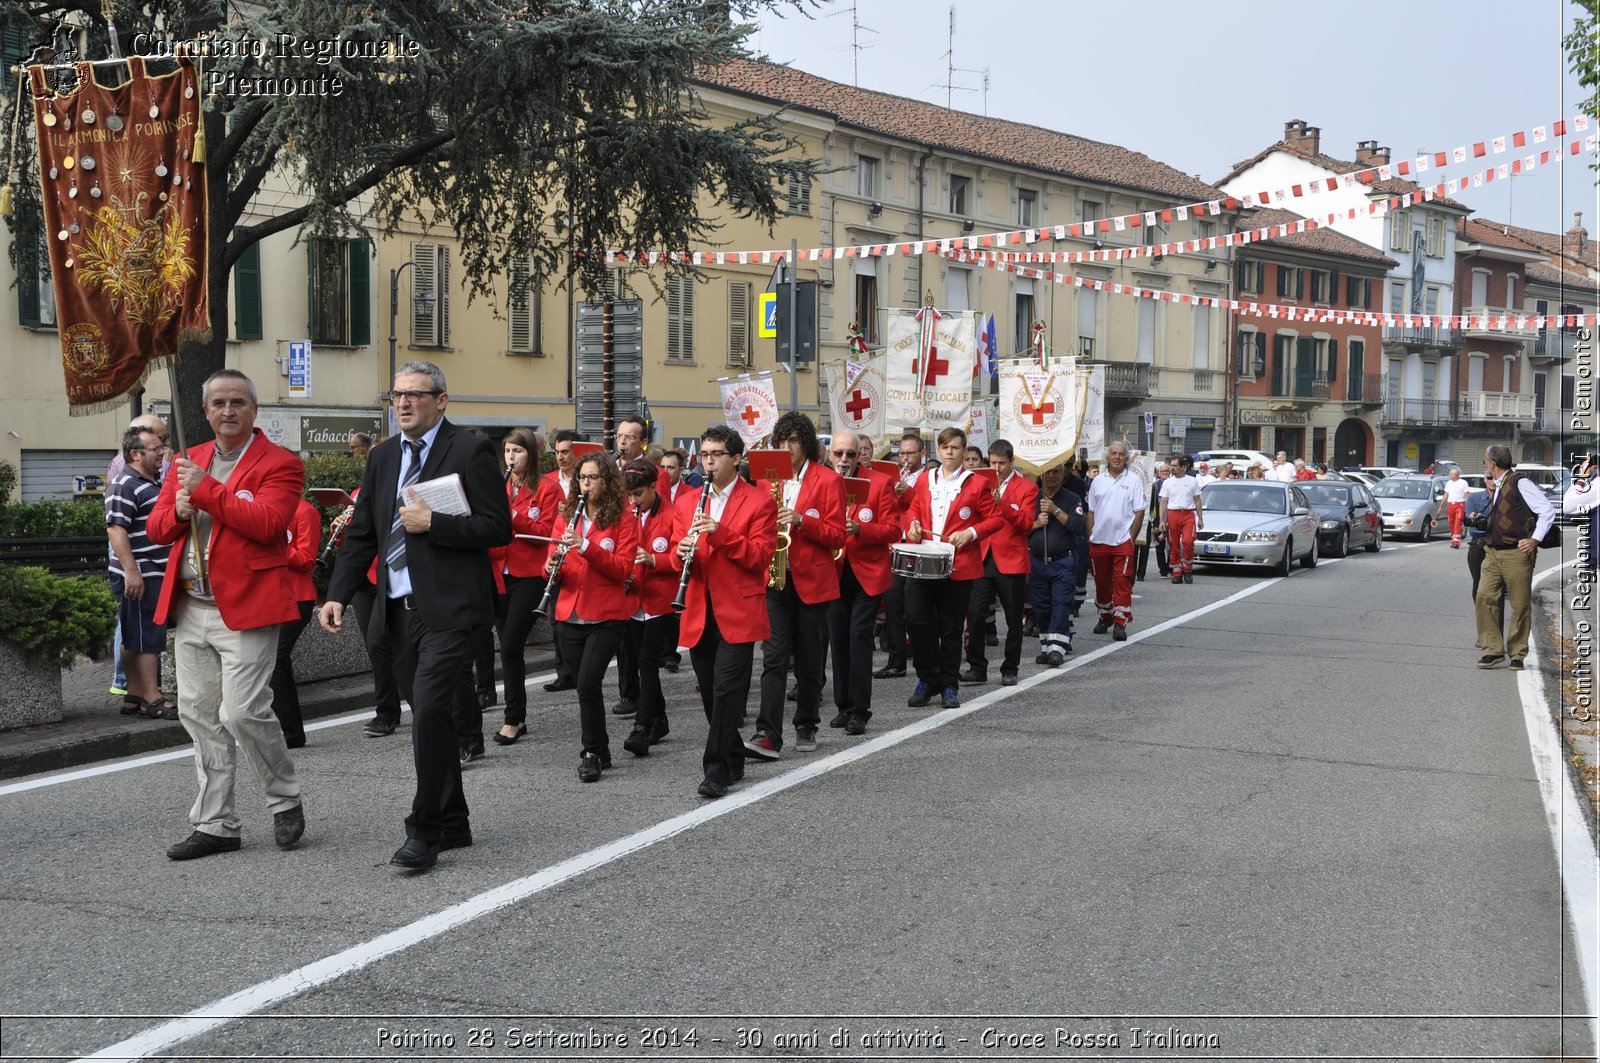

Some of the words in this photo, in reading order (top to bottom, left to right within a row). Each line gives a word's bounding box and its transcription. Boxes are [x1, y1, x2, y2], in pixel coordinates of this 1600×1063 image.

[894, 336, 915, 353] CROCE
[733, 385, 752, 398] ROSSA
[886, 389, 933, 401] COMITTO
[935, 392, 969, 402] LOCALE
[903, 408, 951, 420] POIRINO
[1244, 411, 1276, 424] Gelateria
[306, 427, 377, 443] Tabacchia
[1020, 438, 1059, 446] AIRASCA
